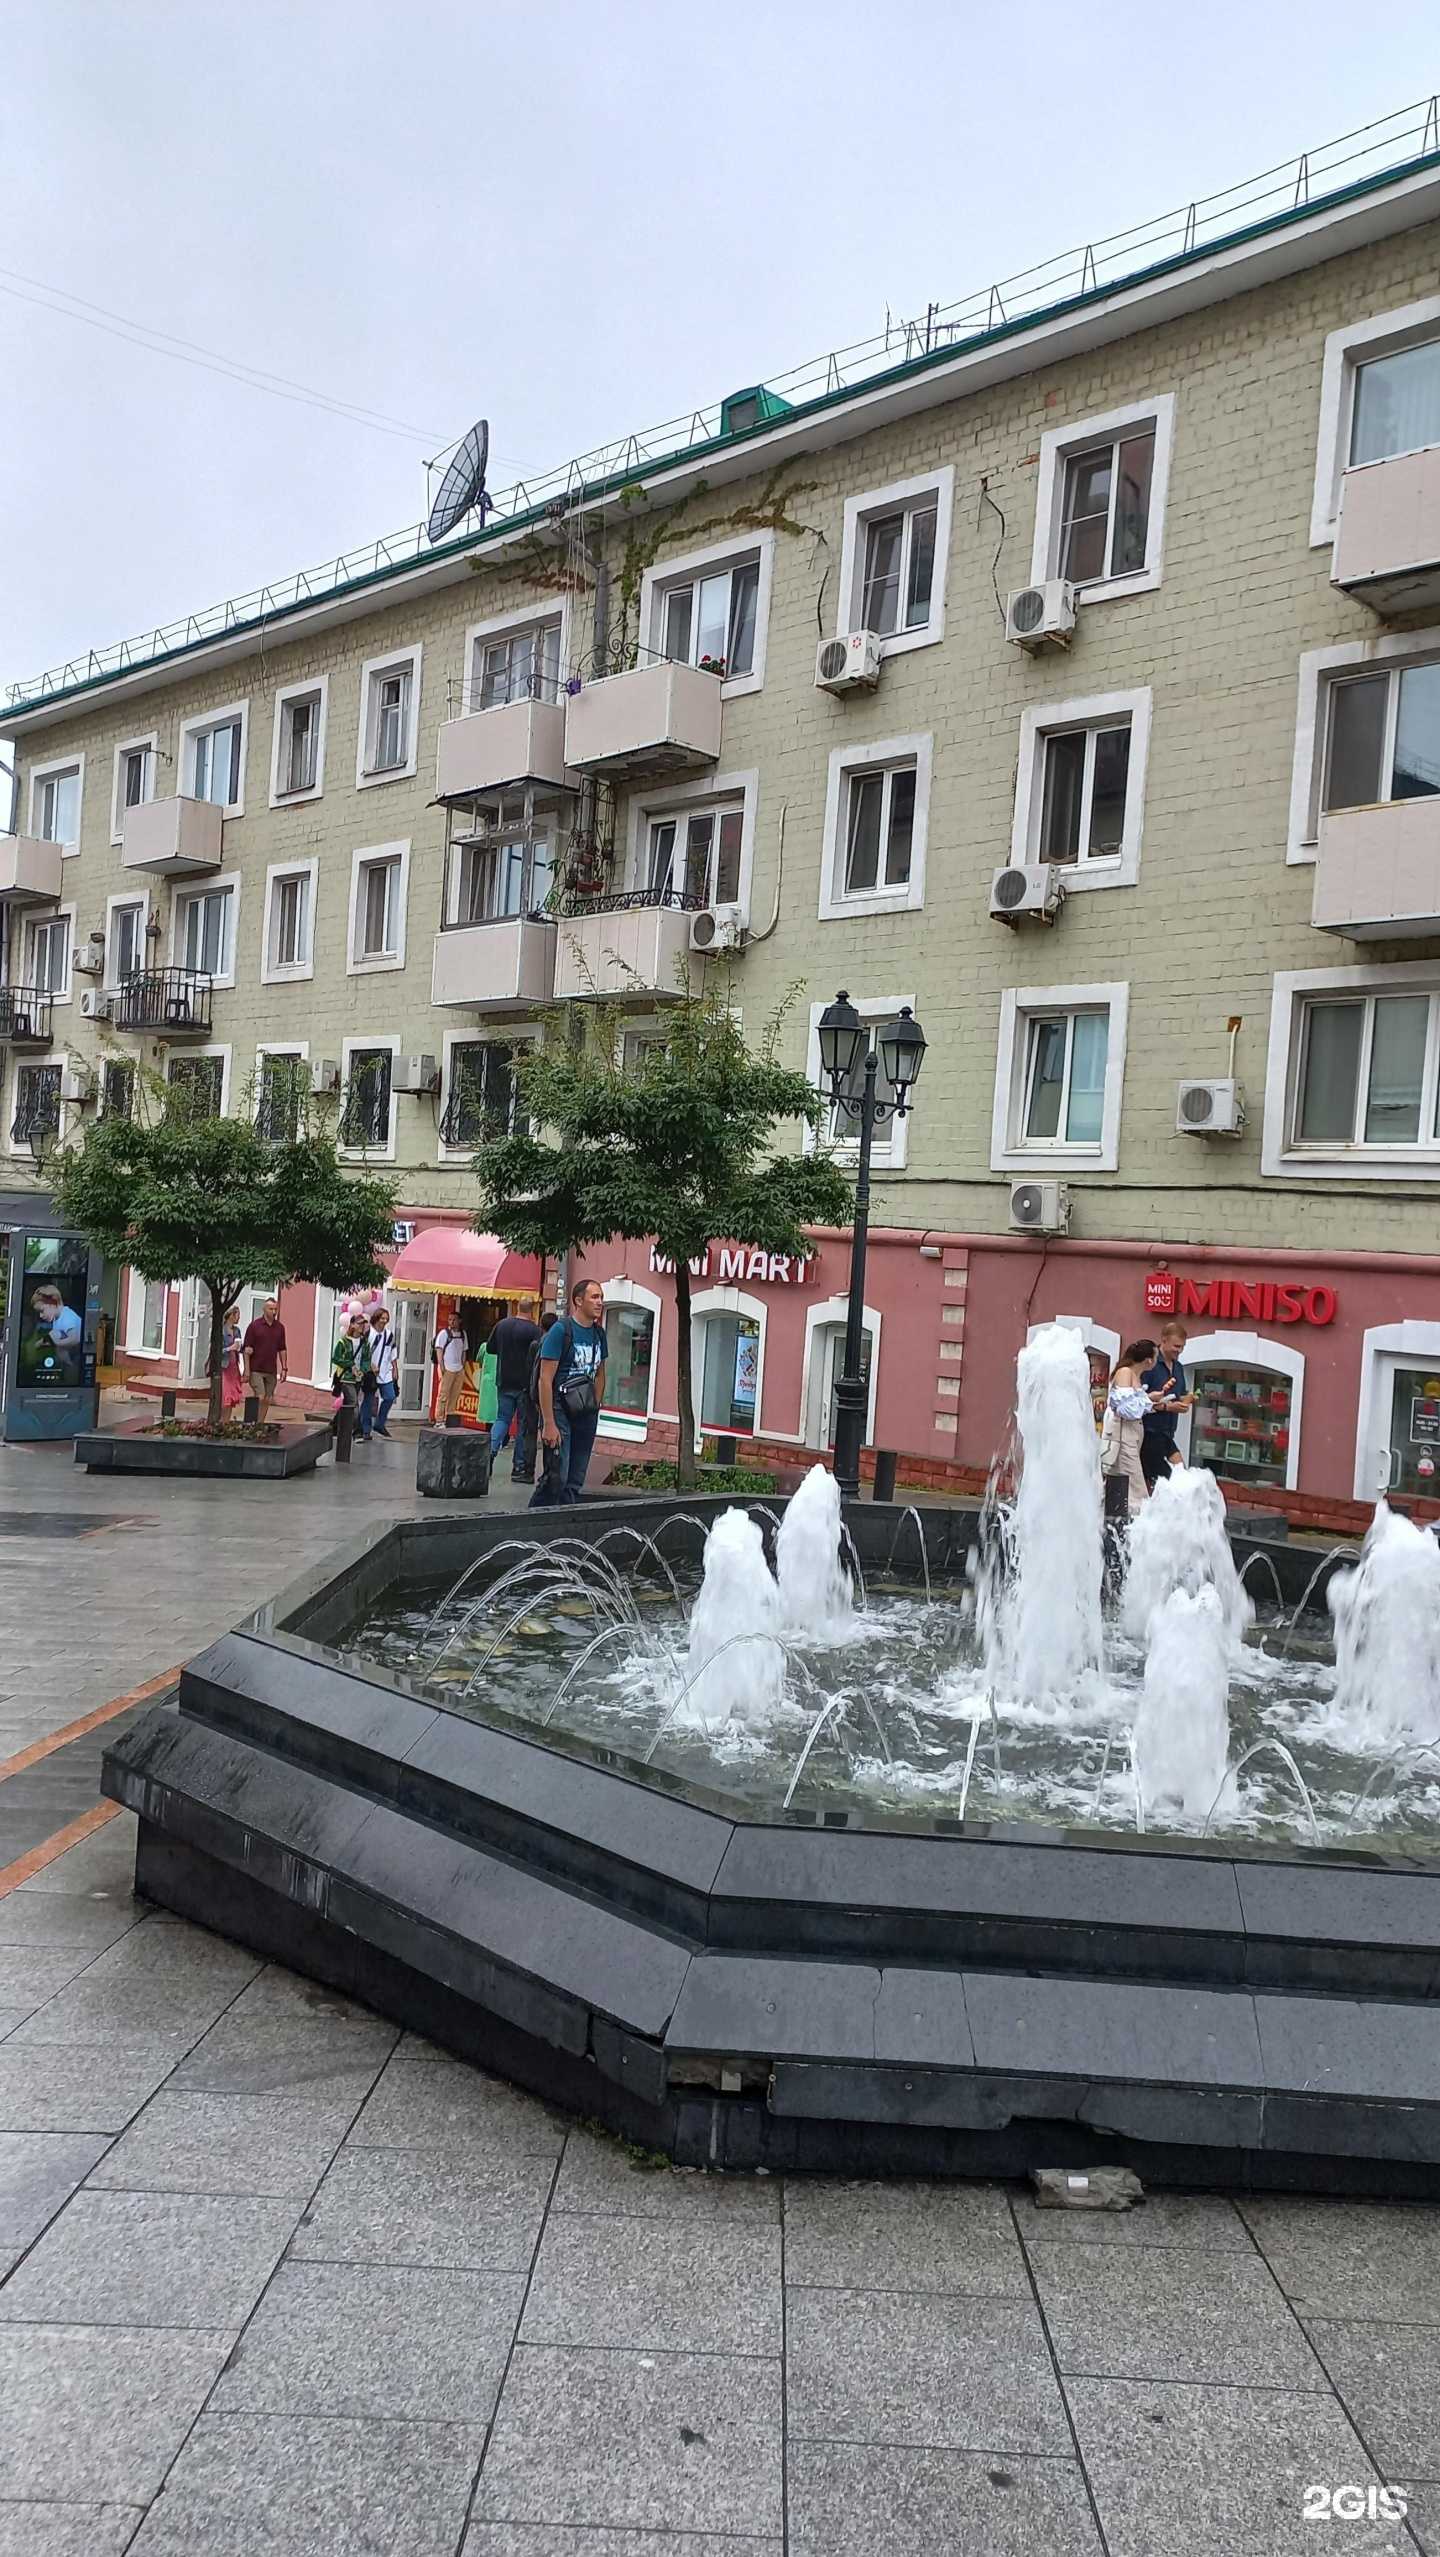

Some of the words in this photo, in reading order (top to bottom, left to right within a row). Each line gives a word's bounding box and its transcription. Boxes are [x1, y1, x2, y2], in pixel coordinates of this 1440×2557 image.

[649, 1244, 709, 1276] MI
[719, 1249, 814, 1284] MART
[1147, 1283, 1172, 1295] MINI
[1181, 1279, 1336, 1325] MINISO
